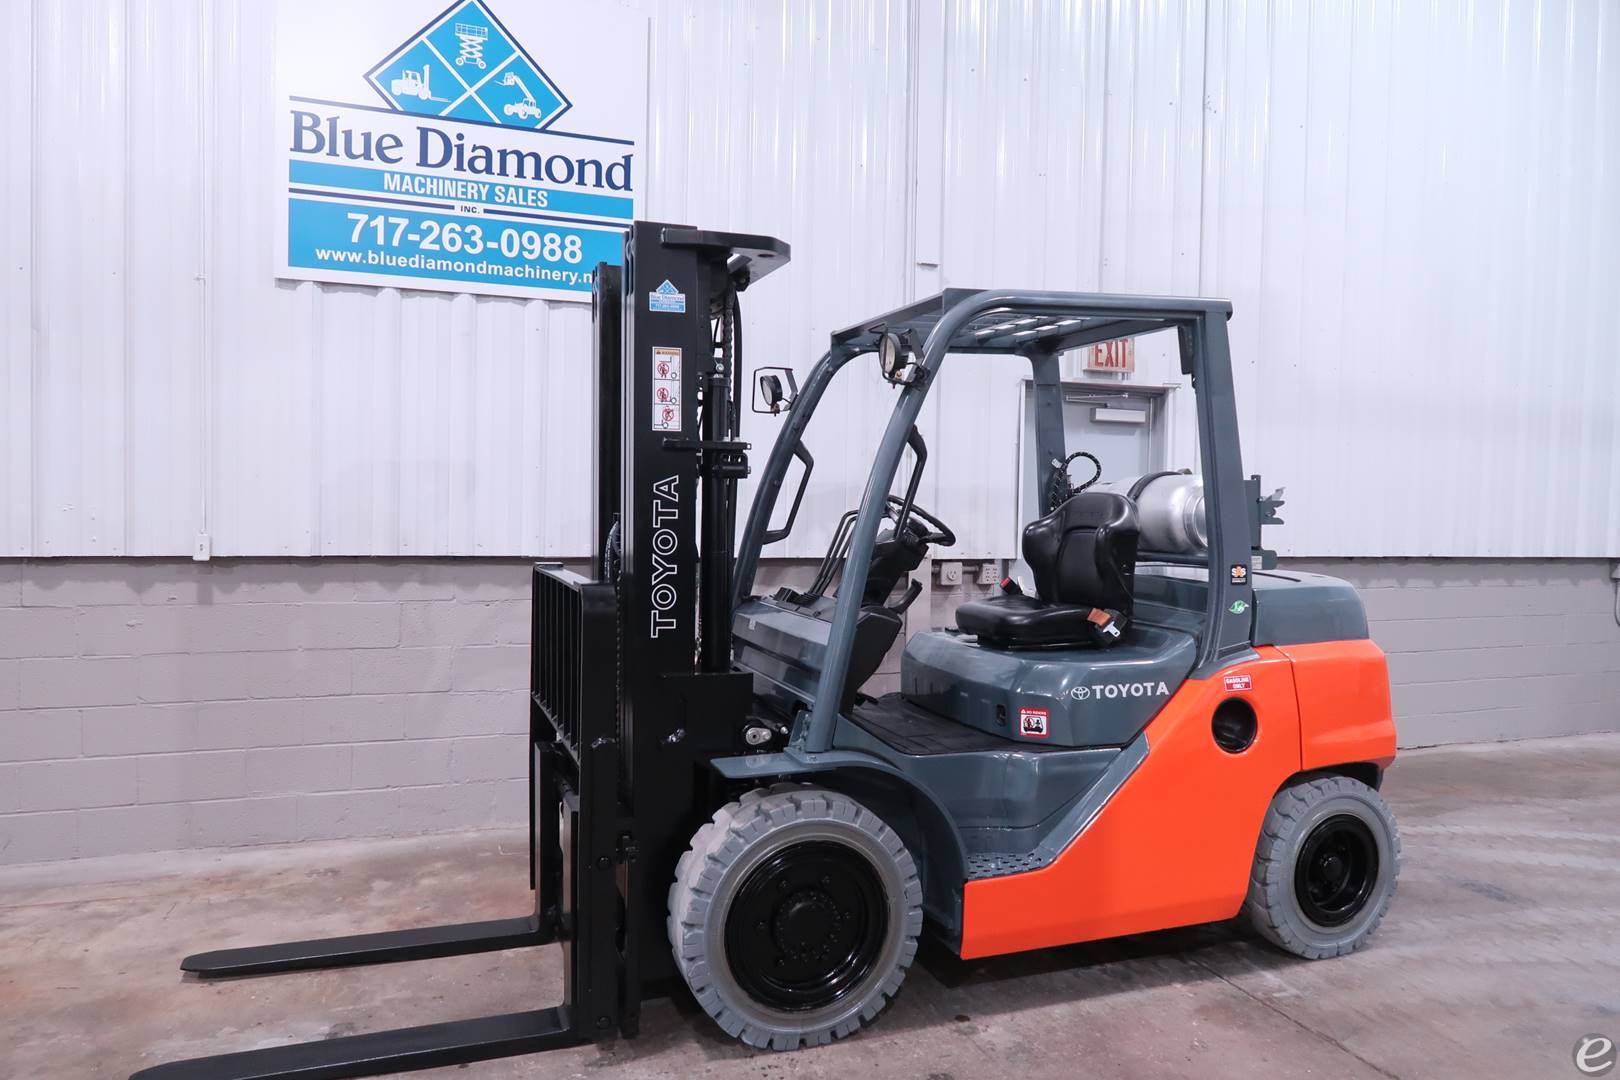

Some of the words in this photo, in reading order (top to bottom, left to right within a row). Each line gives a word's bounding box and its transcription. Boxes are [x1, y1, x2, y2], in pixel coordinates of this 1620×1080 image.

[289, 109, 404, 164] Blue
[416, 126, 633, 191] Diamond
[383, 172, 490, 201] MACHINERY
[494, 186, 549, 208] SALES
[460, 205, 481, 215] INC.
[347, 212, 583, 264] 717-263-0988
[1094, 338, 1129, 368] EXIT
[651, 475, 679, 638] TOYOTA
[1092, 682, 1169, 699] TOYOTA
